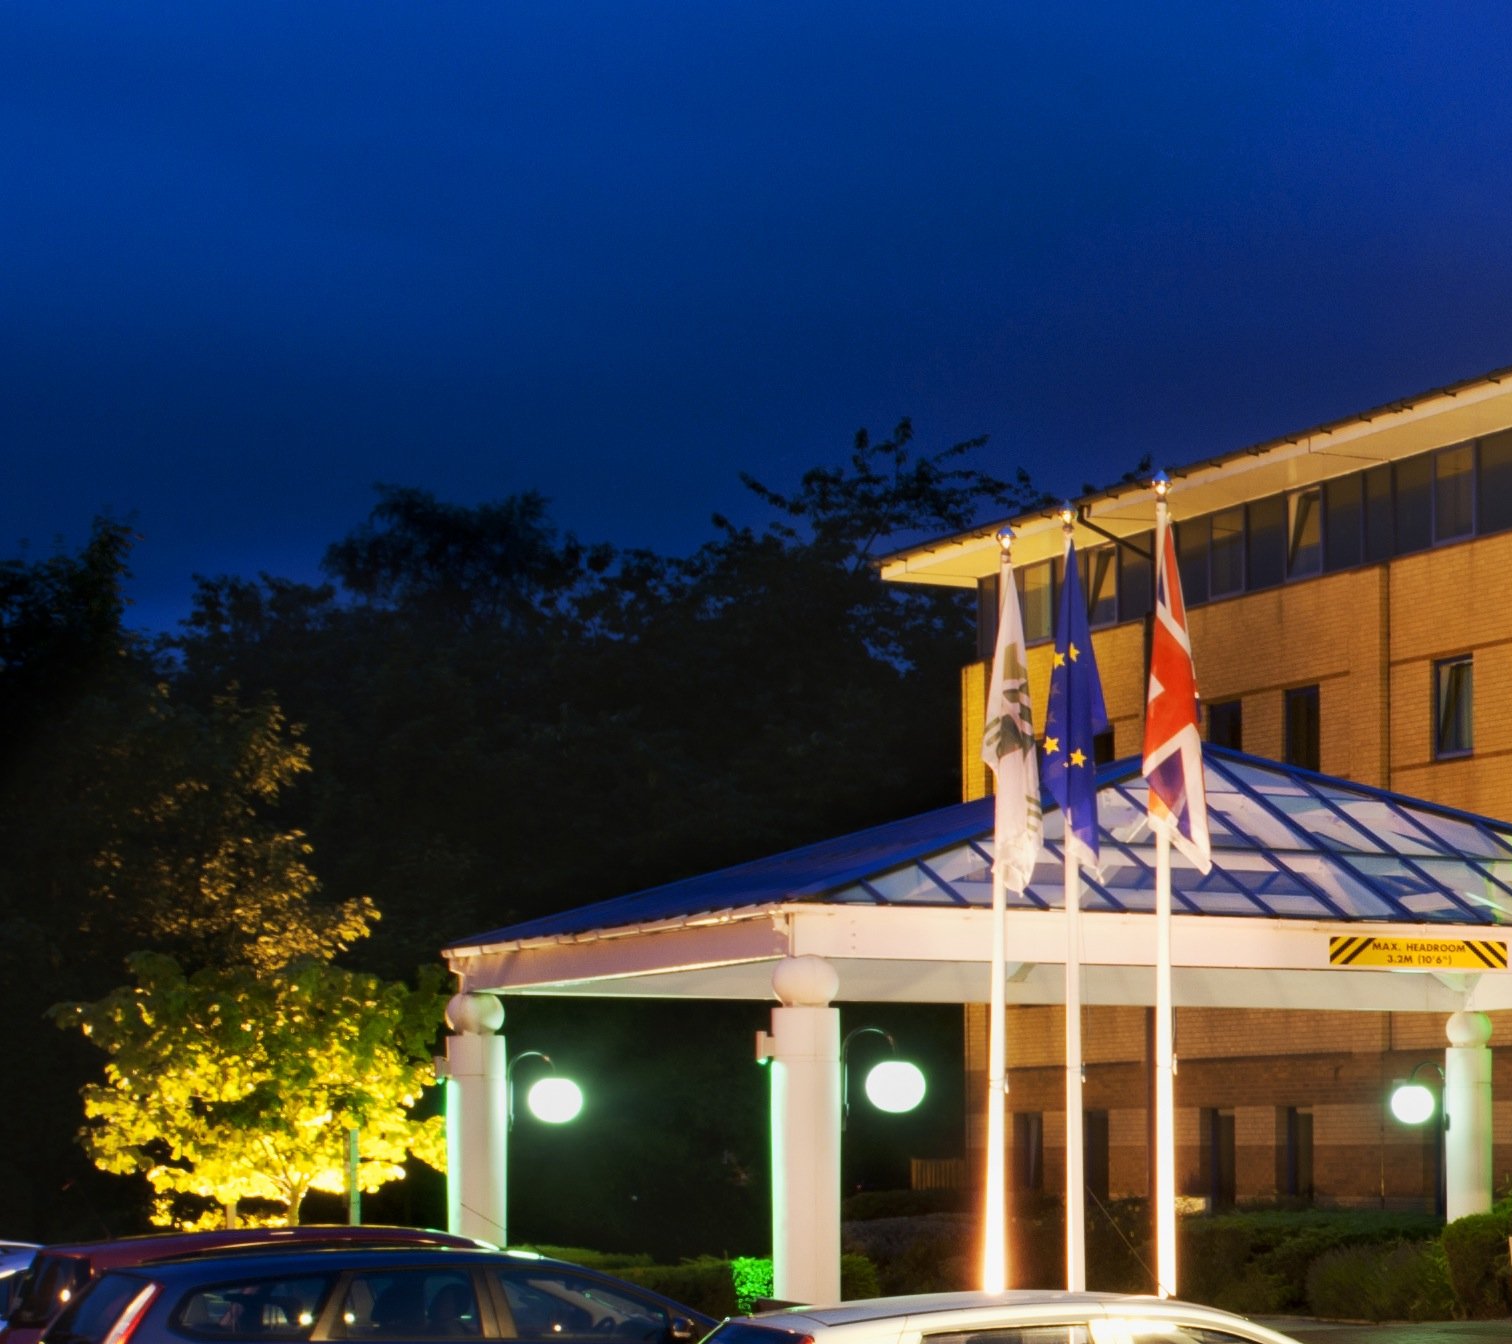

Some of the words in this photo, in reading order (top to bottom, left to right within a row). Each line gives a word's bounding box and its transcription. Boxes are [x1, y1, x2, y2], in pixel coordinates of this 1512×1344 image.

[1372, 942, 1401, 952] MAX.
[1406, 943, 1466, 953] HEADROOM
[1387, 954, 1413, 964] 3.2M
